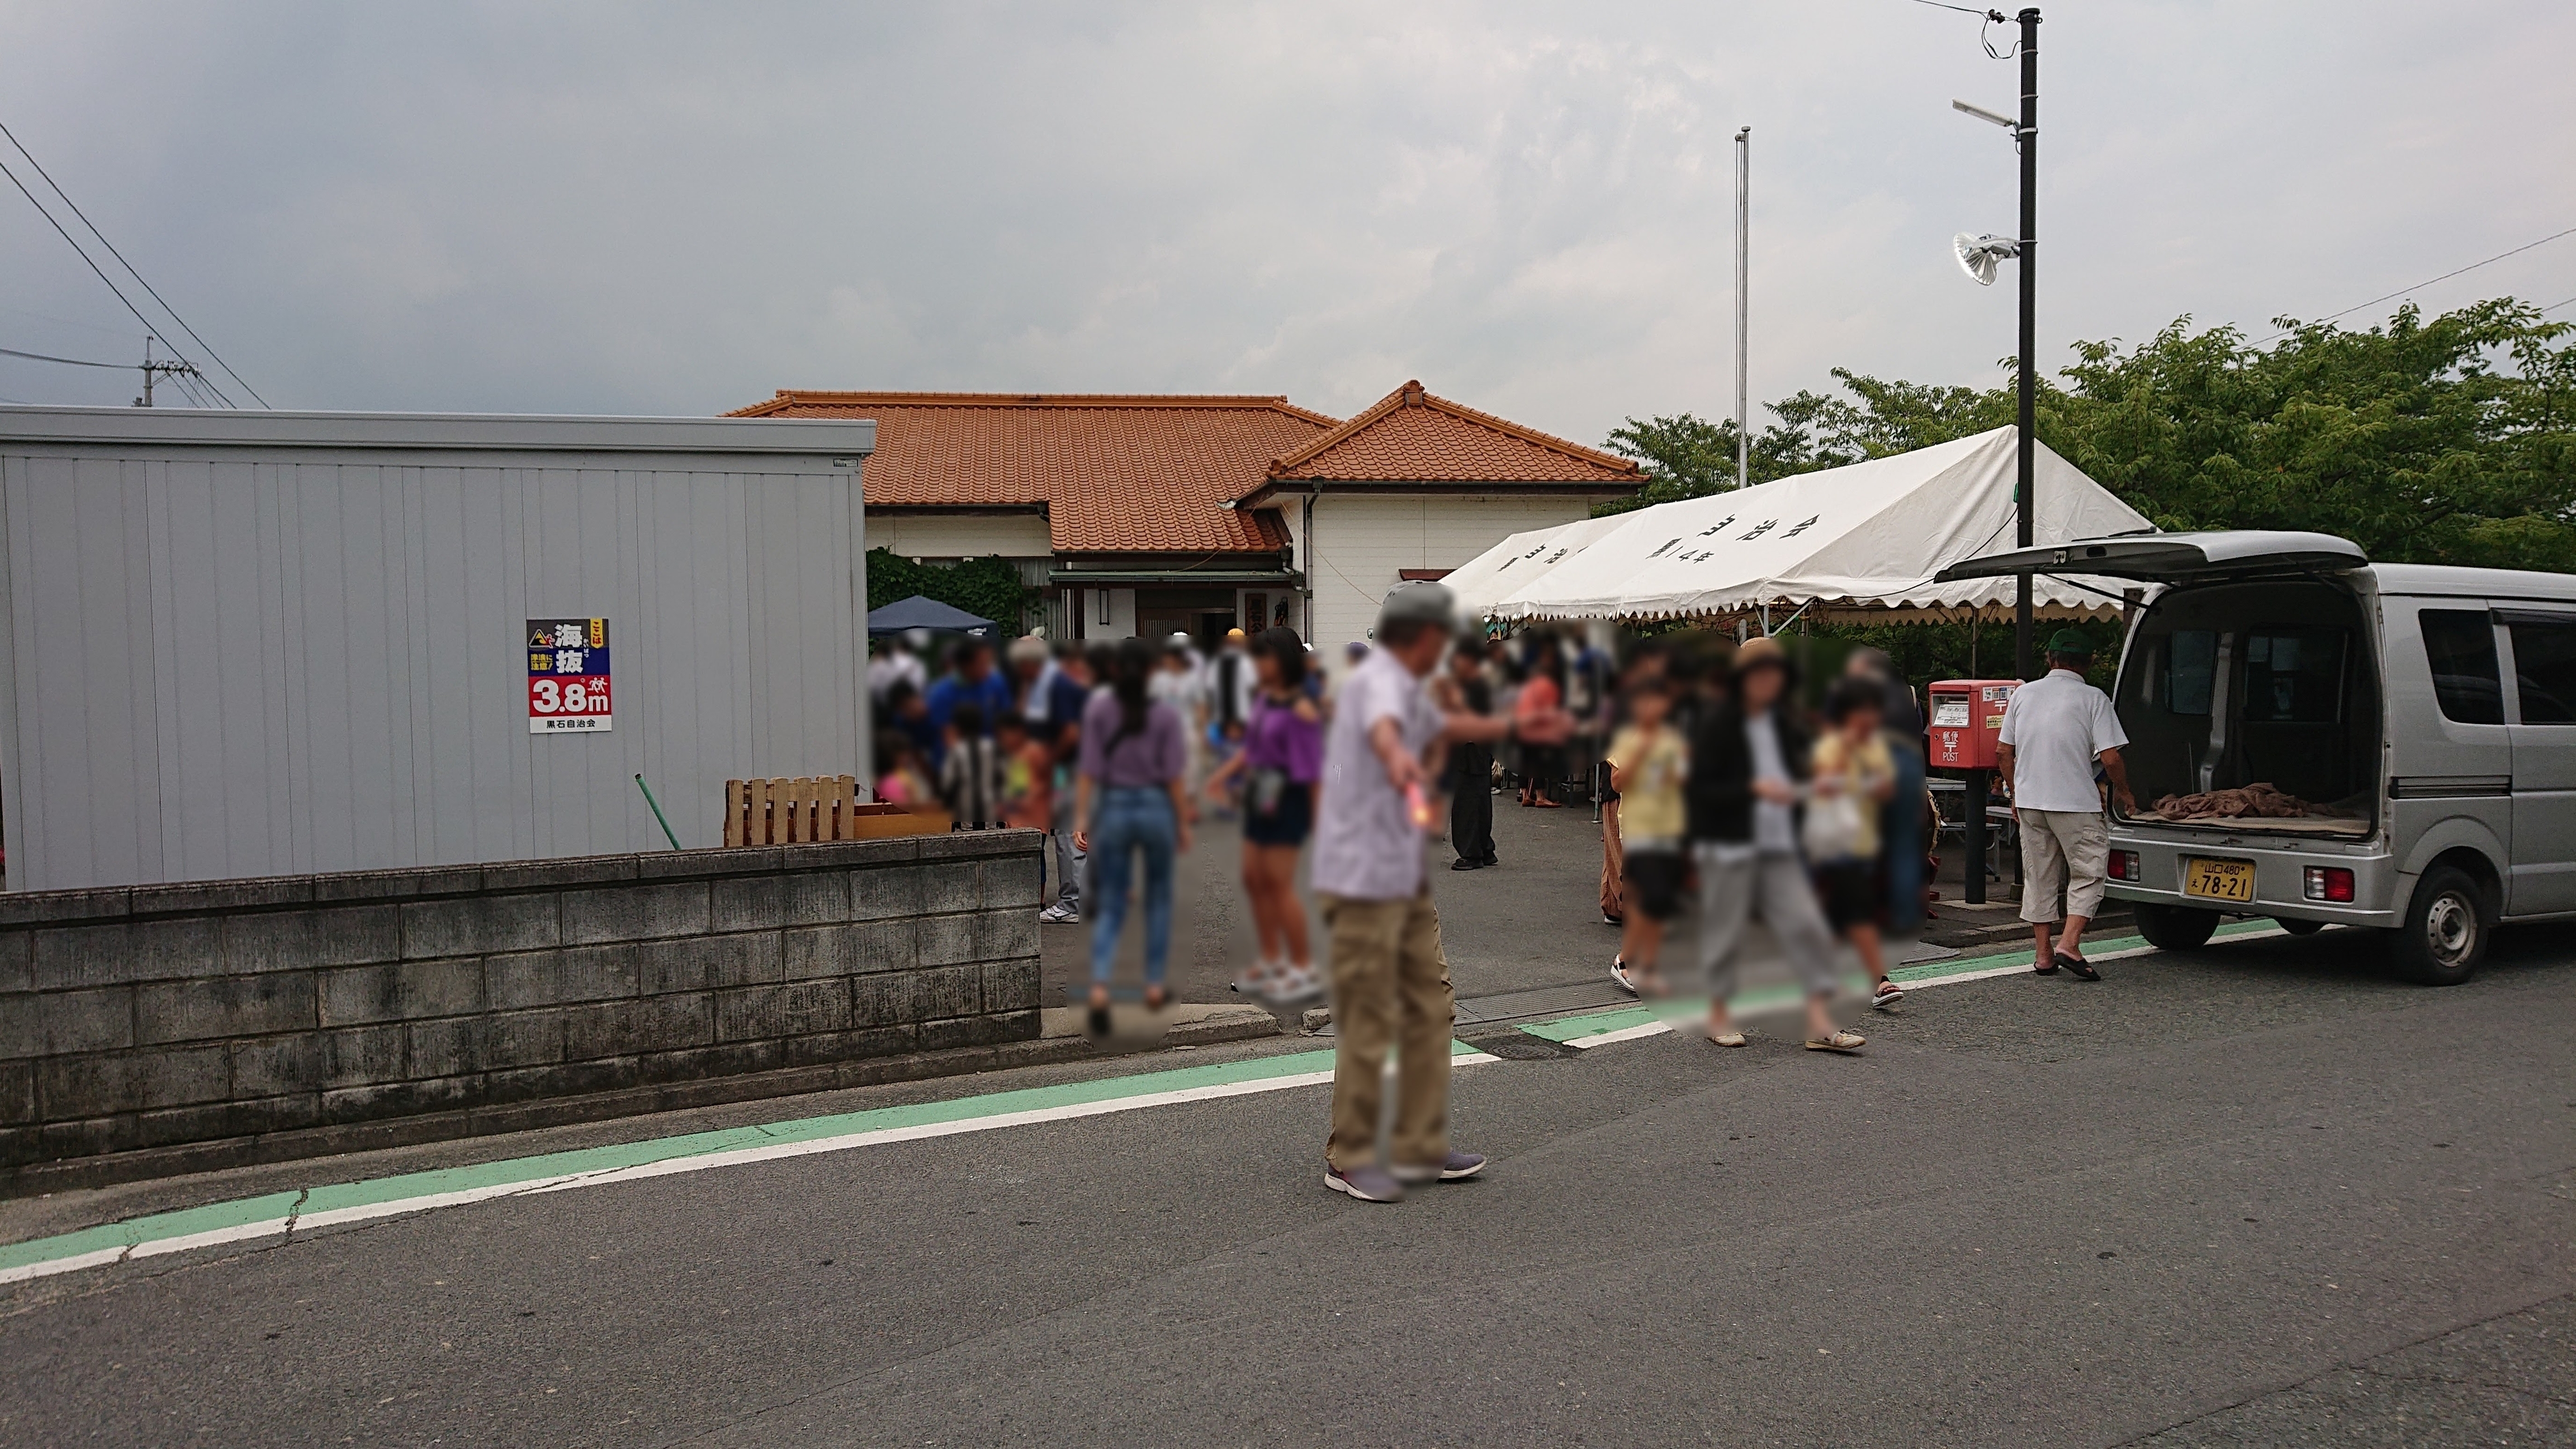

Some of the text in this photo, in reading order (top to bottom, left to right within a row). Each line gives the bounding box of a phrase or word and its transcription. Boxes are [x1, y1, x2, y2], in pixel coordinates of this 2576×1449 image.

[592, 621, 602, 645] ここは
[555, 624, 584, 674] 海抜
[533, 679, 608, 713] 3.8m
[546, 719, 595, 729] 黒石自治会
[1943, 731, 1959, 742] 郵便
[1943, 752, 1959, 762] POST
[2201, 875, 2246, 897] 78-21
